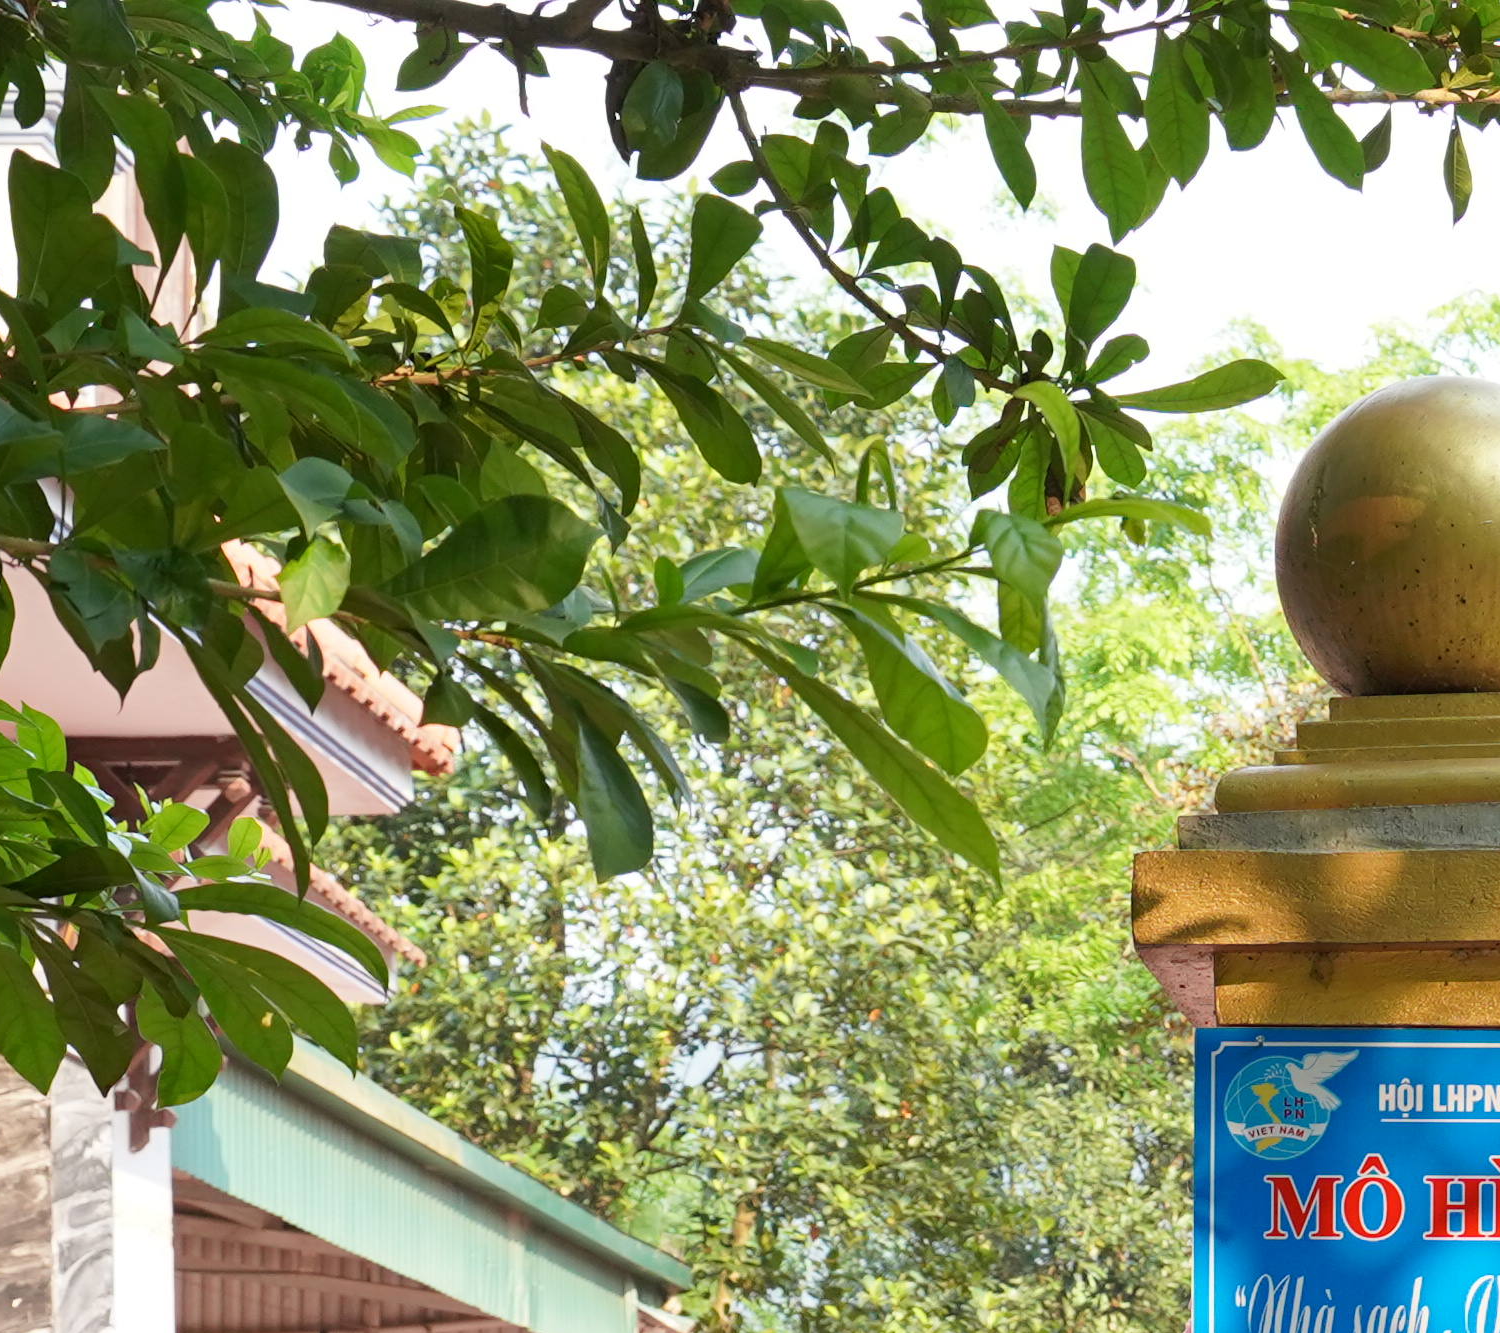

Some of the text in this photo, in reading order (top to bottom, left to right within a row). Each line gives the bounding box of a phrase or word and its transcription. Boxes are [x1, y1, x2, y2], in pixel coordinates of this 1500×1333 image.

[1378, 1077, 1422, 1118] HỘI
[1279, 1125, 1305, 1138] NAM
[1263, 1152, 1405, 1241] MÔ
